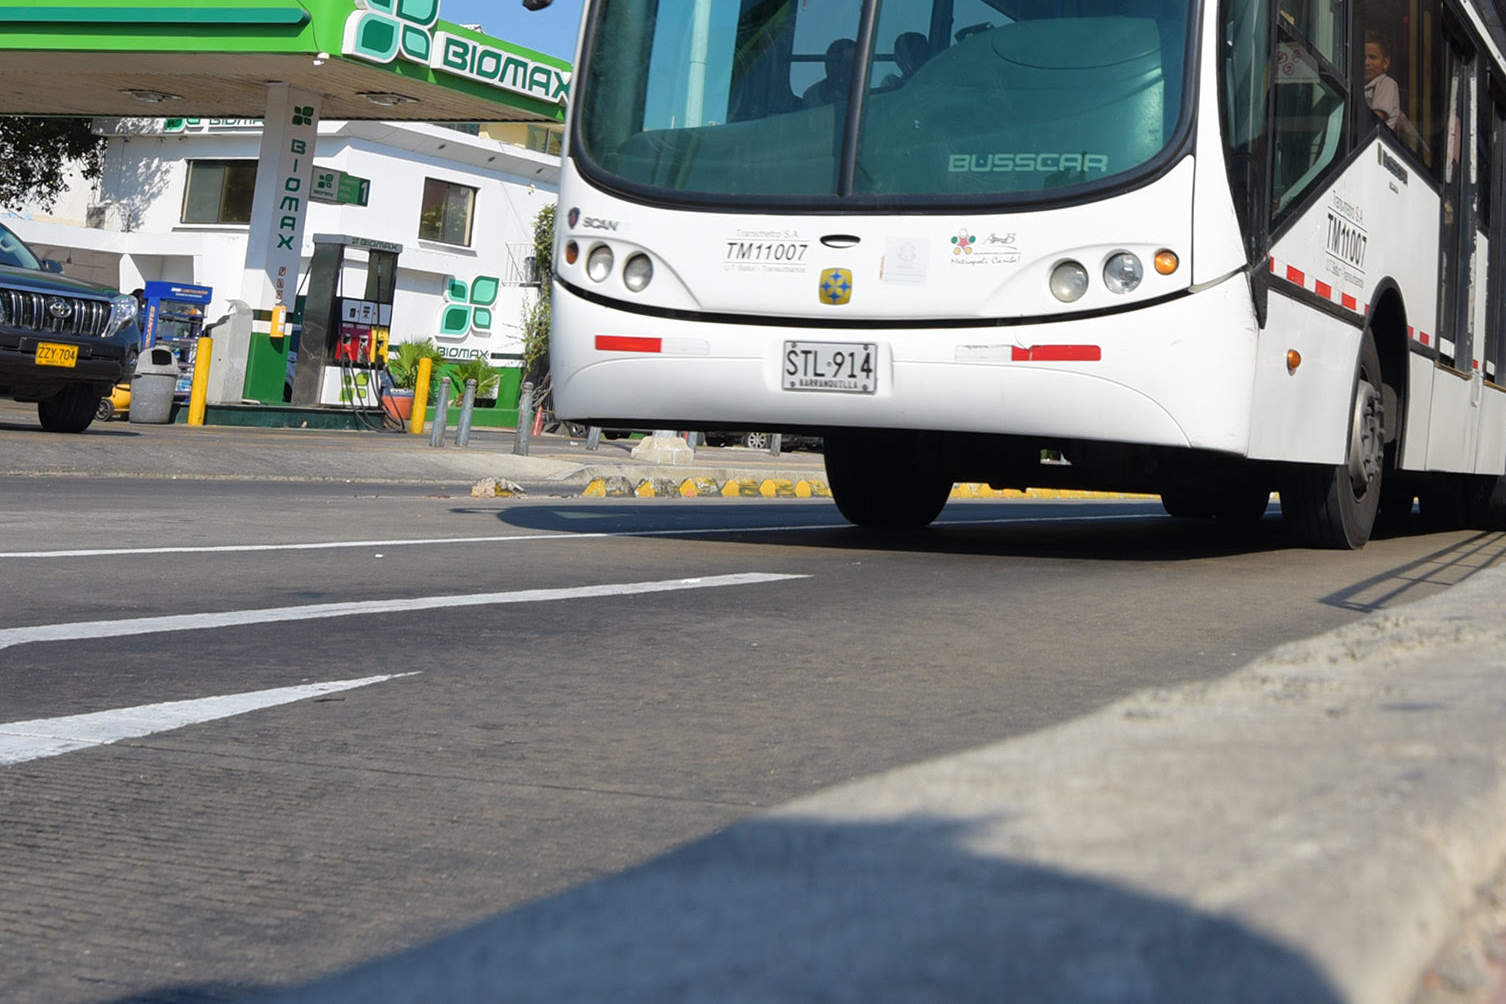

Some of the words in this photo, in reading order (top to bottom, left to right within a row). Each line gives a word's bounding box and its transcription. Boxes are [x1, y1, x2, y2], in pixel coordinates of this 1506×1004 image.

[443, 36, 571, 99] BIOMAX
[948, 153, 1109, 173] BUSSCAR
[276, 139, 307, 251] BIOMAX
[726, 242, 809, 261] TM11007
[1326, 212, 1368, 268] TM11007
[437, 346, 489, 360] BIOMAX
